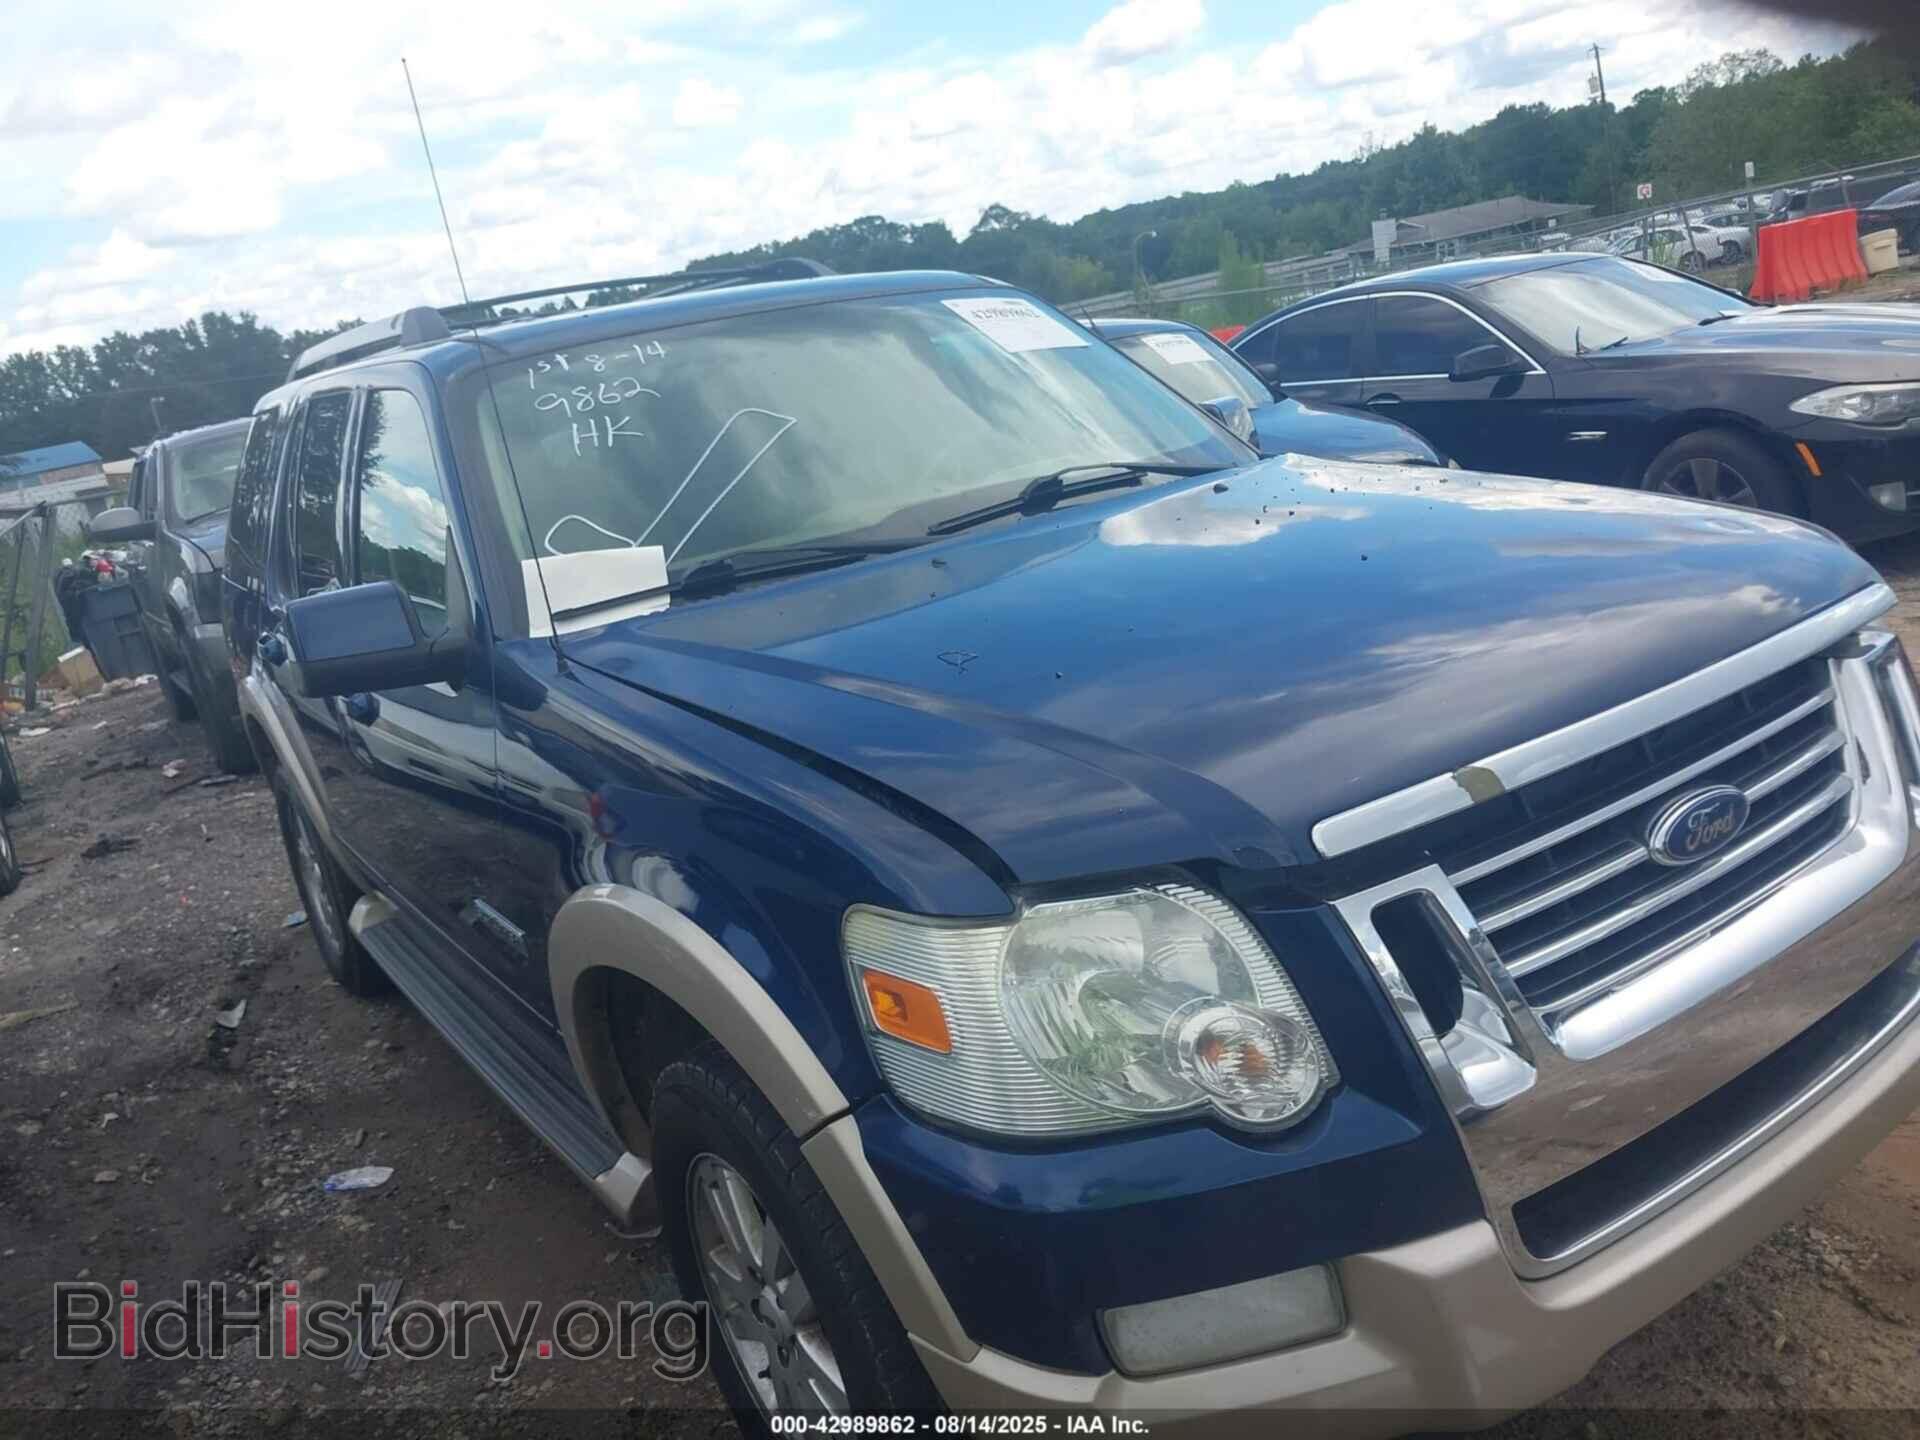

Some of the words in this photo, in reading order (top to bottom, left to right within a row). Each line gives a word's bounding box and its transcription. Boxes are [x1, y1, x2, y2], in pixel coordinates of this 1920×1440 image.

[534, 377, 662, 418] 9862
[572, 415, 644, 456] HK
[1686, 801, 1735, 851] Ford
